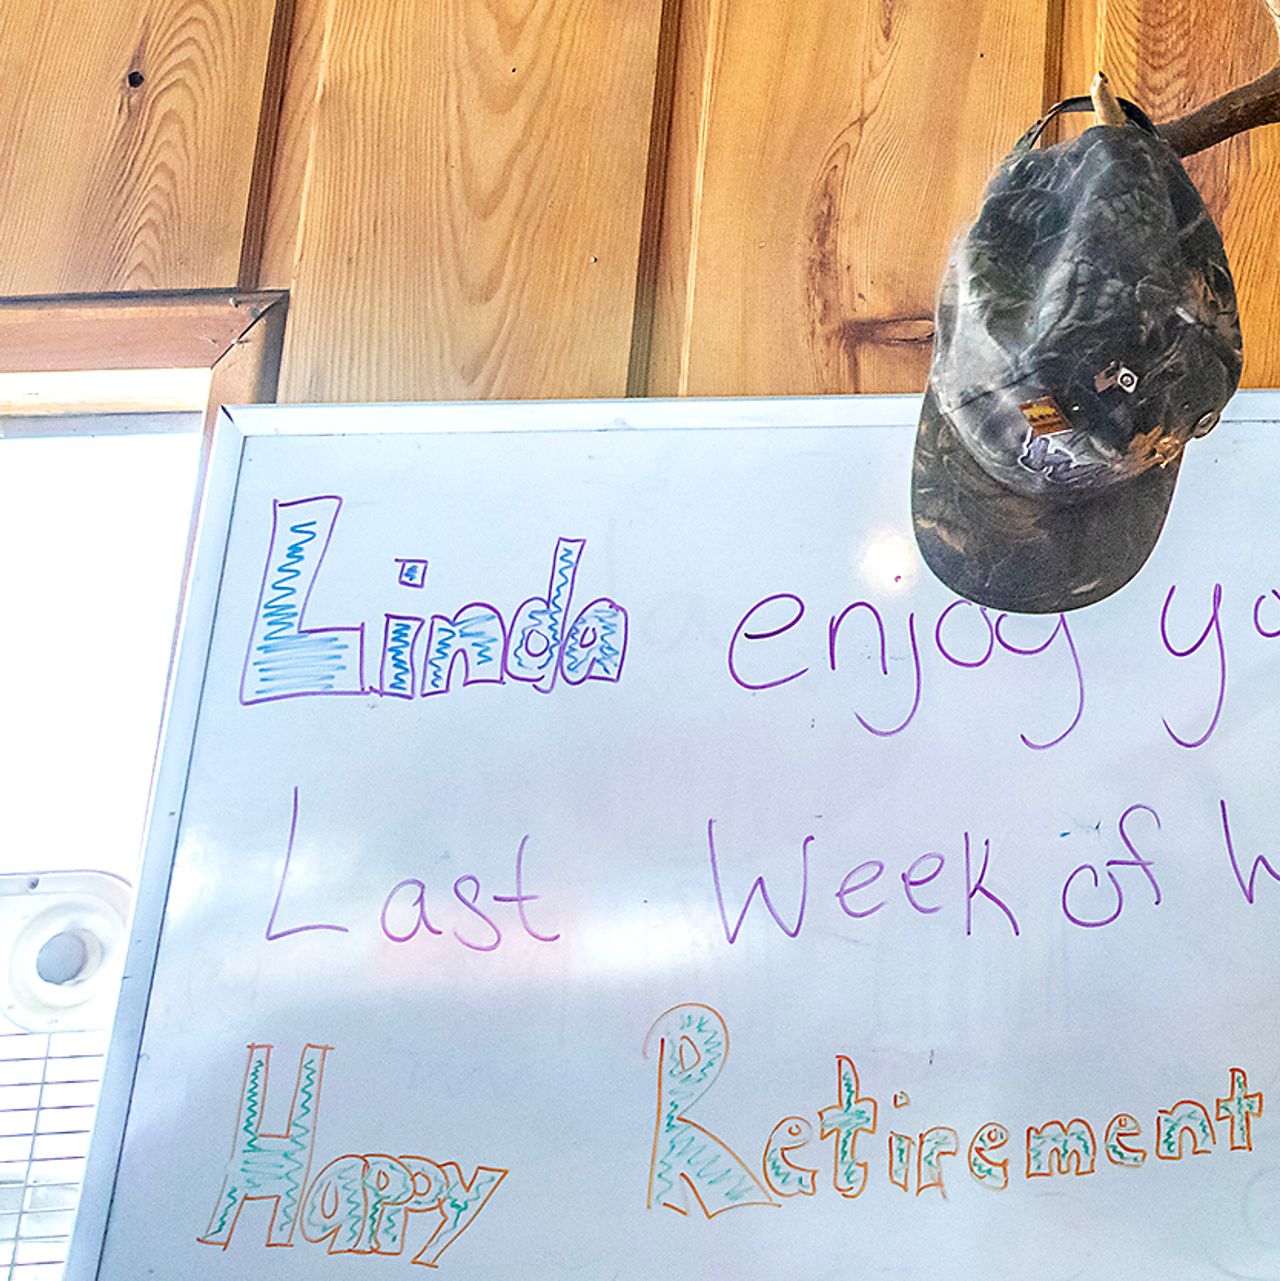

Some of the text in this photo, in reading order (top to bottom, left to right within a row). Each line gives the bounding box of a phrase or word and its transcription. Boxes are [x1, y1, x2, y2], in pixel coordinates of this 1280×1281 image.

[239, 495, 629, 705] Linda
[728, 575, 1085, 750] enjoy
[265, 786, 562, 952] Last
[707, 817, 1022, 945] Week
[1061, 802, 1162, 928] of
[196, 1042, 509, 1268] Happy
